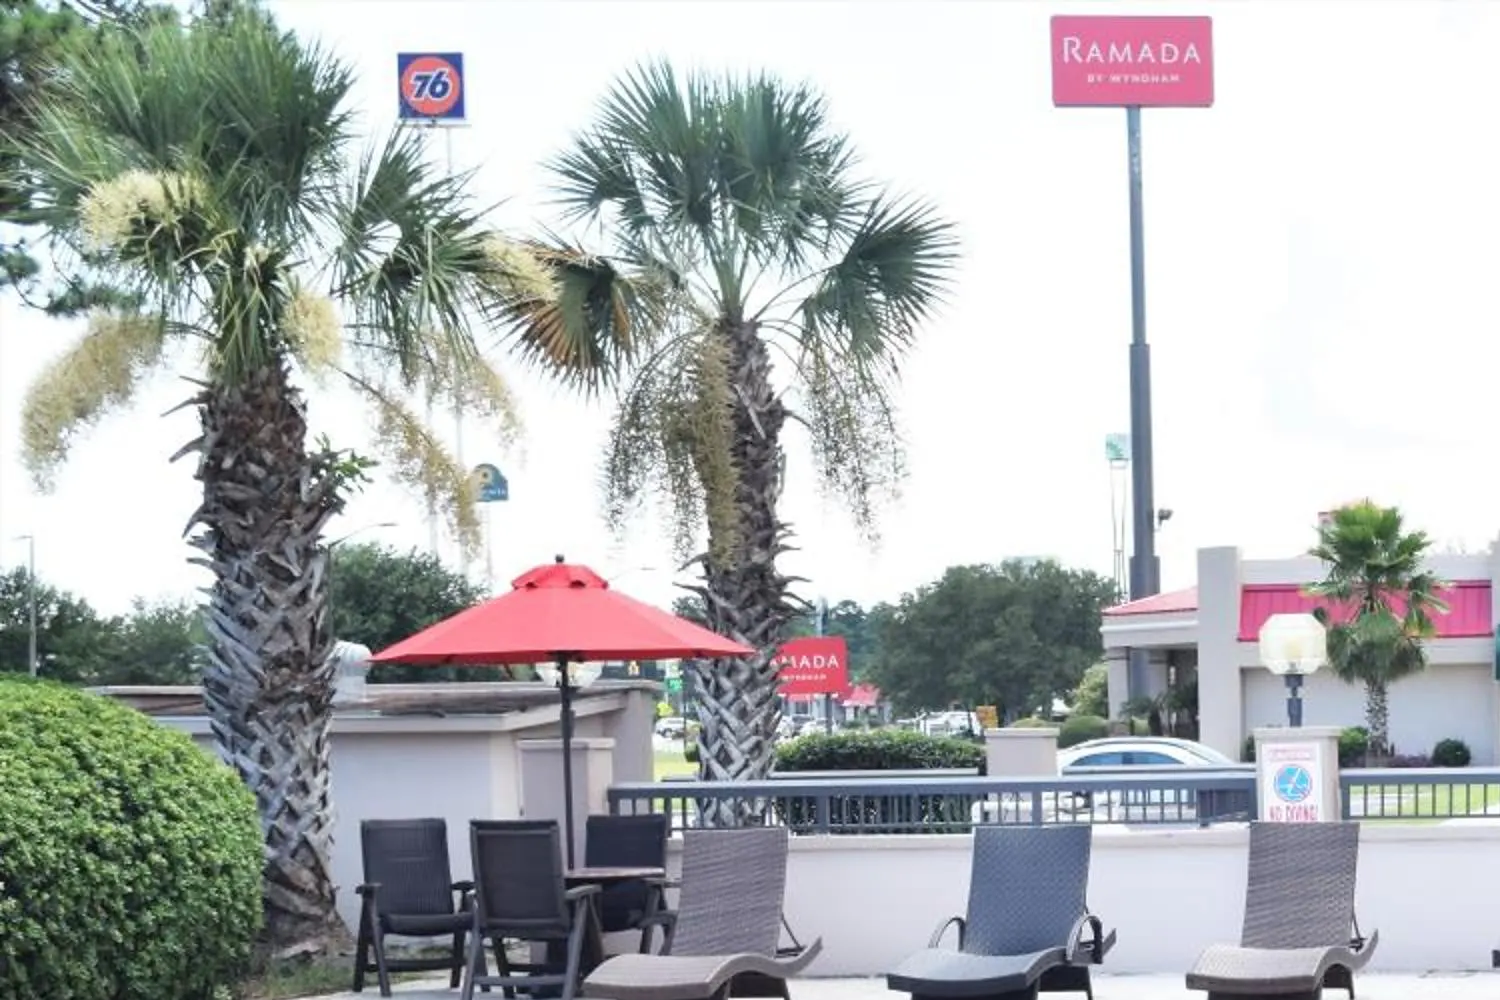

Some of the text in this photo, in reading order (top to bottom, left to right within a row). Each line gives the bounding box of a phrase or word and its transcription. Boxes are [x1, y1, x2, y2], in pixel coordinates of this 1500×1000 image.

[1062, 36, 1201, 64] RAMADA
[410, 68, 453, 101] 76
[769, 655, 840, 668] AMADA
